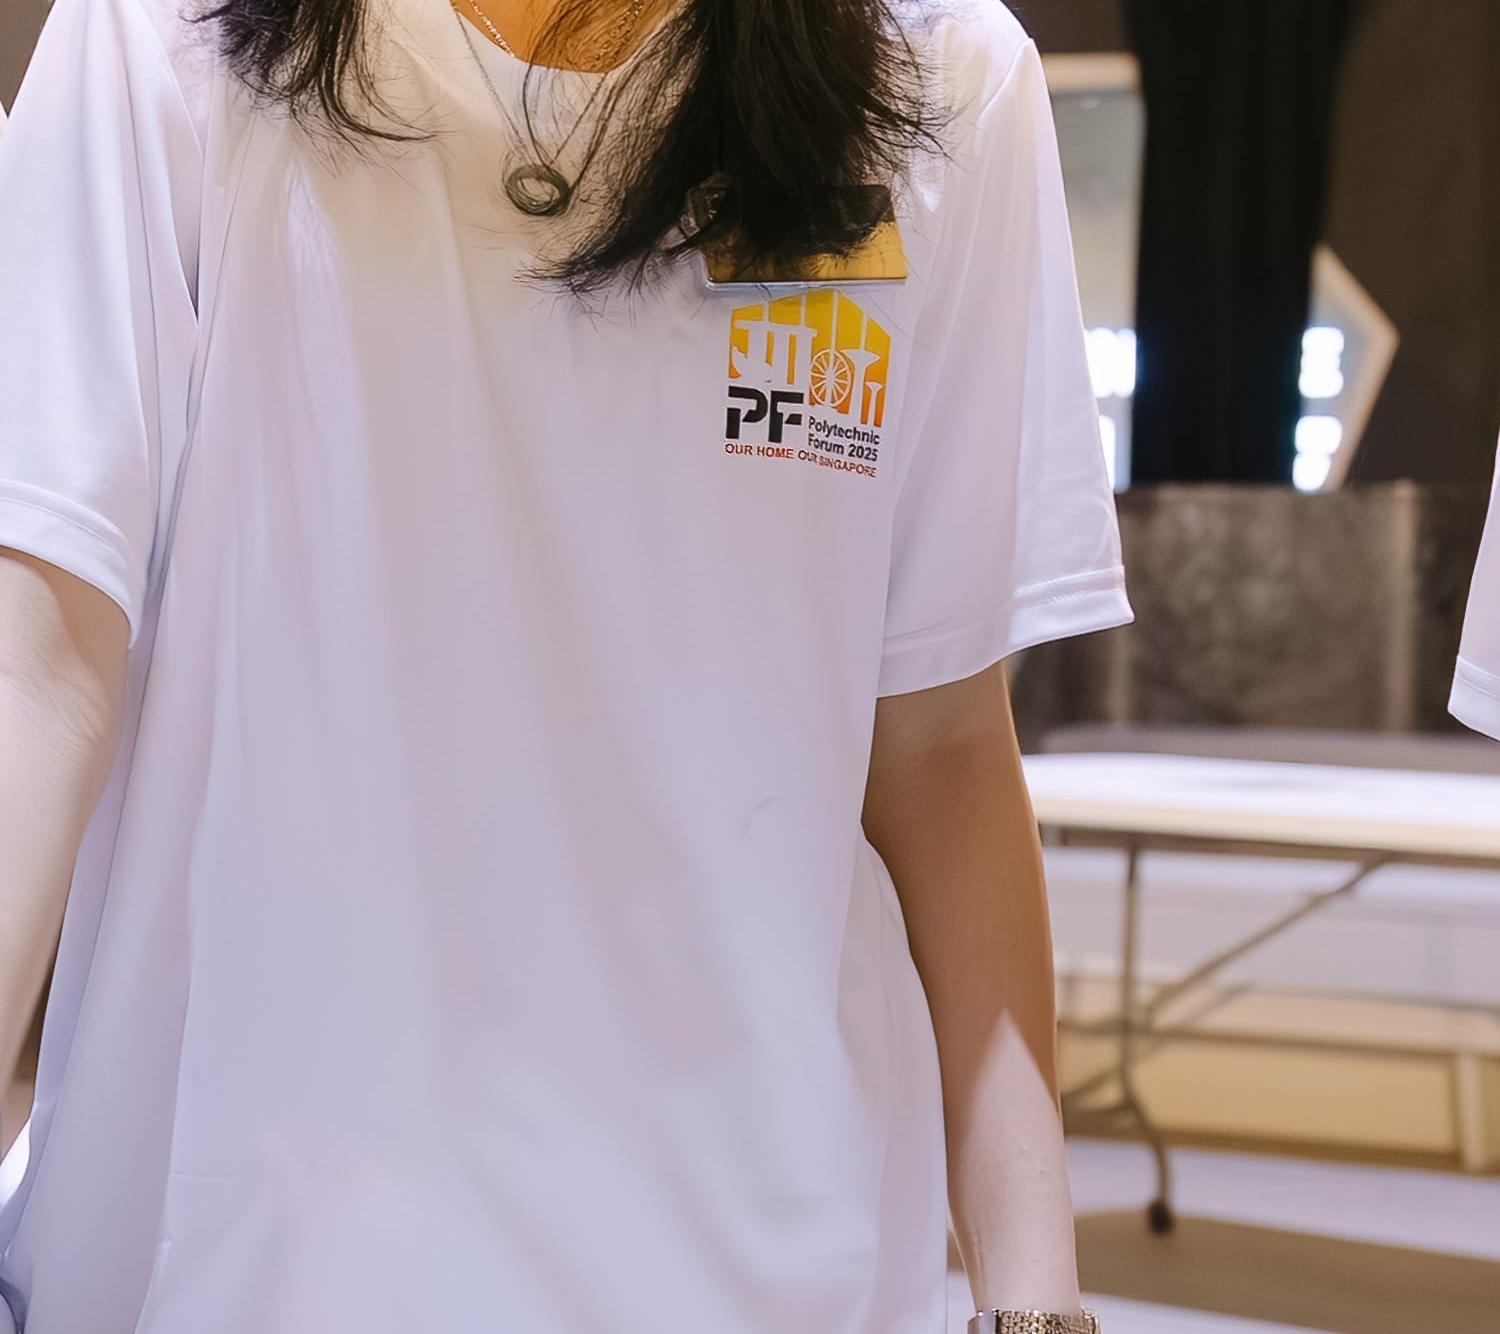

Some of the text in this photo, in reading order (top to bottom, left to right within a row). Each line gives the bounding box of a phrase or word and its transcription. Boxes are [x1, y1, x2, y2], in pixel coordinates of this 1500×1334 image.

[724, 385, 805, 444] PF
[808, 416, 880, 445] Polytechnic
[725, 443, 878, 478] OUR HOME OUR SINGAPORE
[807, 433, 879, 462] Forum 2025
